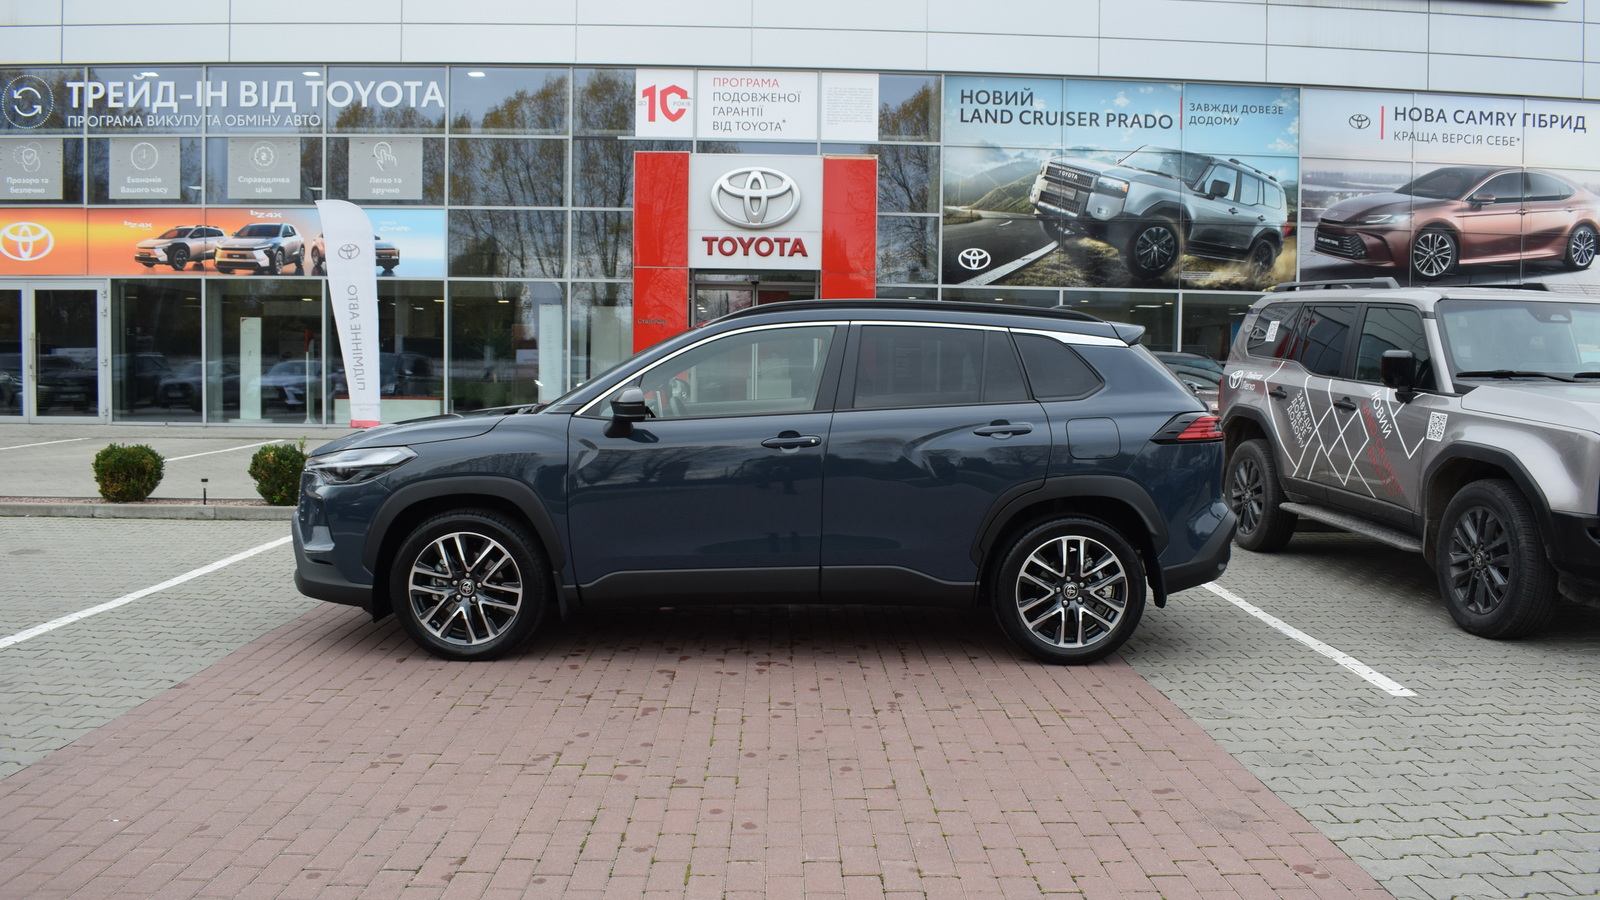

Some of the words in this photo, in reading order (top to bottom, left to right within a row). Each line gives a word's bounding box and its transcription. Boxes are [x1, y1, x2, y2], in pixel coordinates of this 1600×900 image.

[713, 77, 780, 88] ПРОГРАМА
[66, 73, 228, 114] ТРЕЙД-ІН
[239, 80, 297, 113] ВІД
[305, 80, 446, 108] TOYOTA
[712, 91, 802, 103] ПОДОВЖЕНОЇ
[960, 87, 1034, 107] НОВИЙ
[712, 105, 764, 117] ГАРАНТІЇ
[1189, 102, 1239, 114] ЗАВЖДИ
[1240, 105, 1284, 116] ДОВЕЗЕ
[67, 115, 142, 127] ПРОГРАМА
[147, 114, 202, 127] ВИКУПУ
[204, 114, 221, 126] ТА
[225, 114, 281, 127] ОБМІНУ
[283, 114, 321, 127] АВТО
[959, 108, 1013, 125] LAND
[1018, 111, 1101, 127] CRUISER
[1106, 113, 1174, 130] PRADO
[1189, 115, 1240, 127] ДОДОМУ
[1393, 106, 1448, 124] НОВА
[1453, 109, 1518, 128] CAMRY
[1522, 113, 1588, 133] ГІБРИД
[712, 121, 733, 132] ВІД
[1393, 131, 1438, 144] КРАЩА
[1442, 133, 1483, 145] ВЕРСІЯ
[6, 176, 38, 186] Прозоро
[126, 176, 162, 184] Економія
[237, 175, 290, 185] Справедлива
[369, 176, 391, 184] Легко
[1058, 170, 1079, 180] TOYOTA
[9, 186, 46, 194] безпечно
[120, 186, 150, 194] Вашого
[255, 186, 273, 195] ціна
[371, 187, 400, 195] зручно
[701, 236, 809, 258] TOYOTA
[1296, 389, 1313, 434] ЗАВЖДИ
[1360, 398, 1378, 437] LAND
[1371, 389, 1393, 440] НОВИЙ
